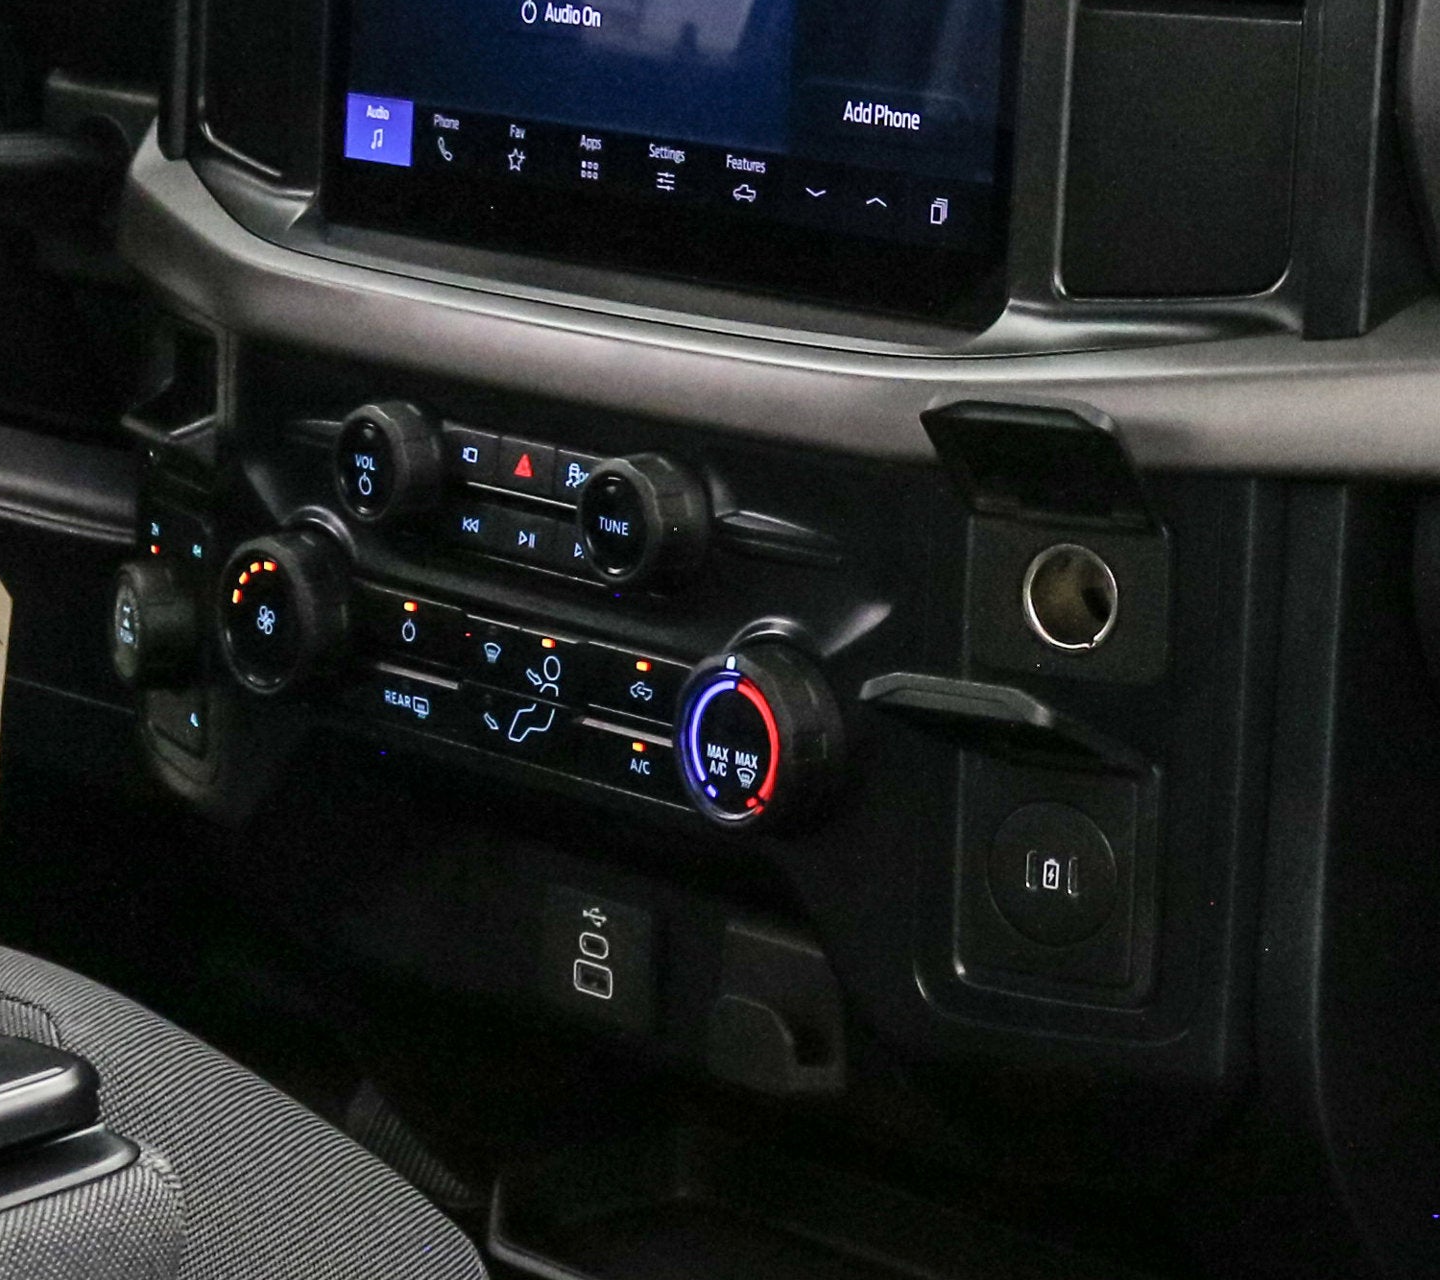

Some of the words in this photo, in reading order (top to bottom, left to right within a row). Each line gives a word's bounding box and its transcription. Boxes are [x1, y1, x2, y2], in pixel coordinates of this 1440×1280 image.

[544, 1, 582, 27] Audio
[581, 5, 602, 28] On
[366, 104, 390, 121] Audio
[842, 100, 877, 125] Add
[876, 104, 921, 131] Phone
[433, 113, 460, 130] Phone
[509, 124, 526, 139] Fav
[579, 134, 602, 151] Apps
[648, 143, 686, 164] Settings
[726, 154, 766, 174] Features
[355, 455, 376, 471] VOL
[599, 516, 629, 536] TUNE
[384, 690, 412, 708] REAR
[707, 743, 729, 760] MAX
[734, 750, 758, 768] MAX
[630, 758, 651, 775] A/C
[709, 760, 729, 777] A/C
